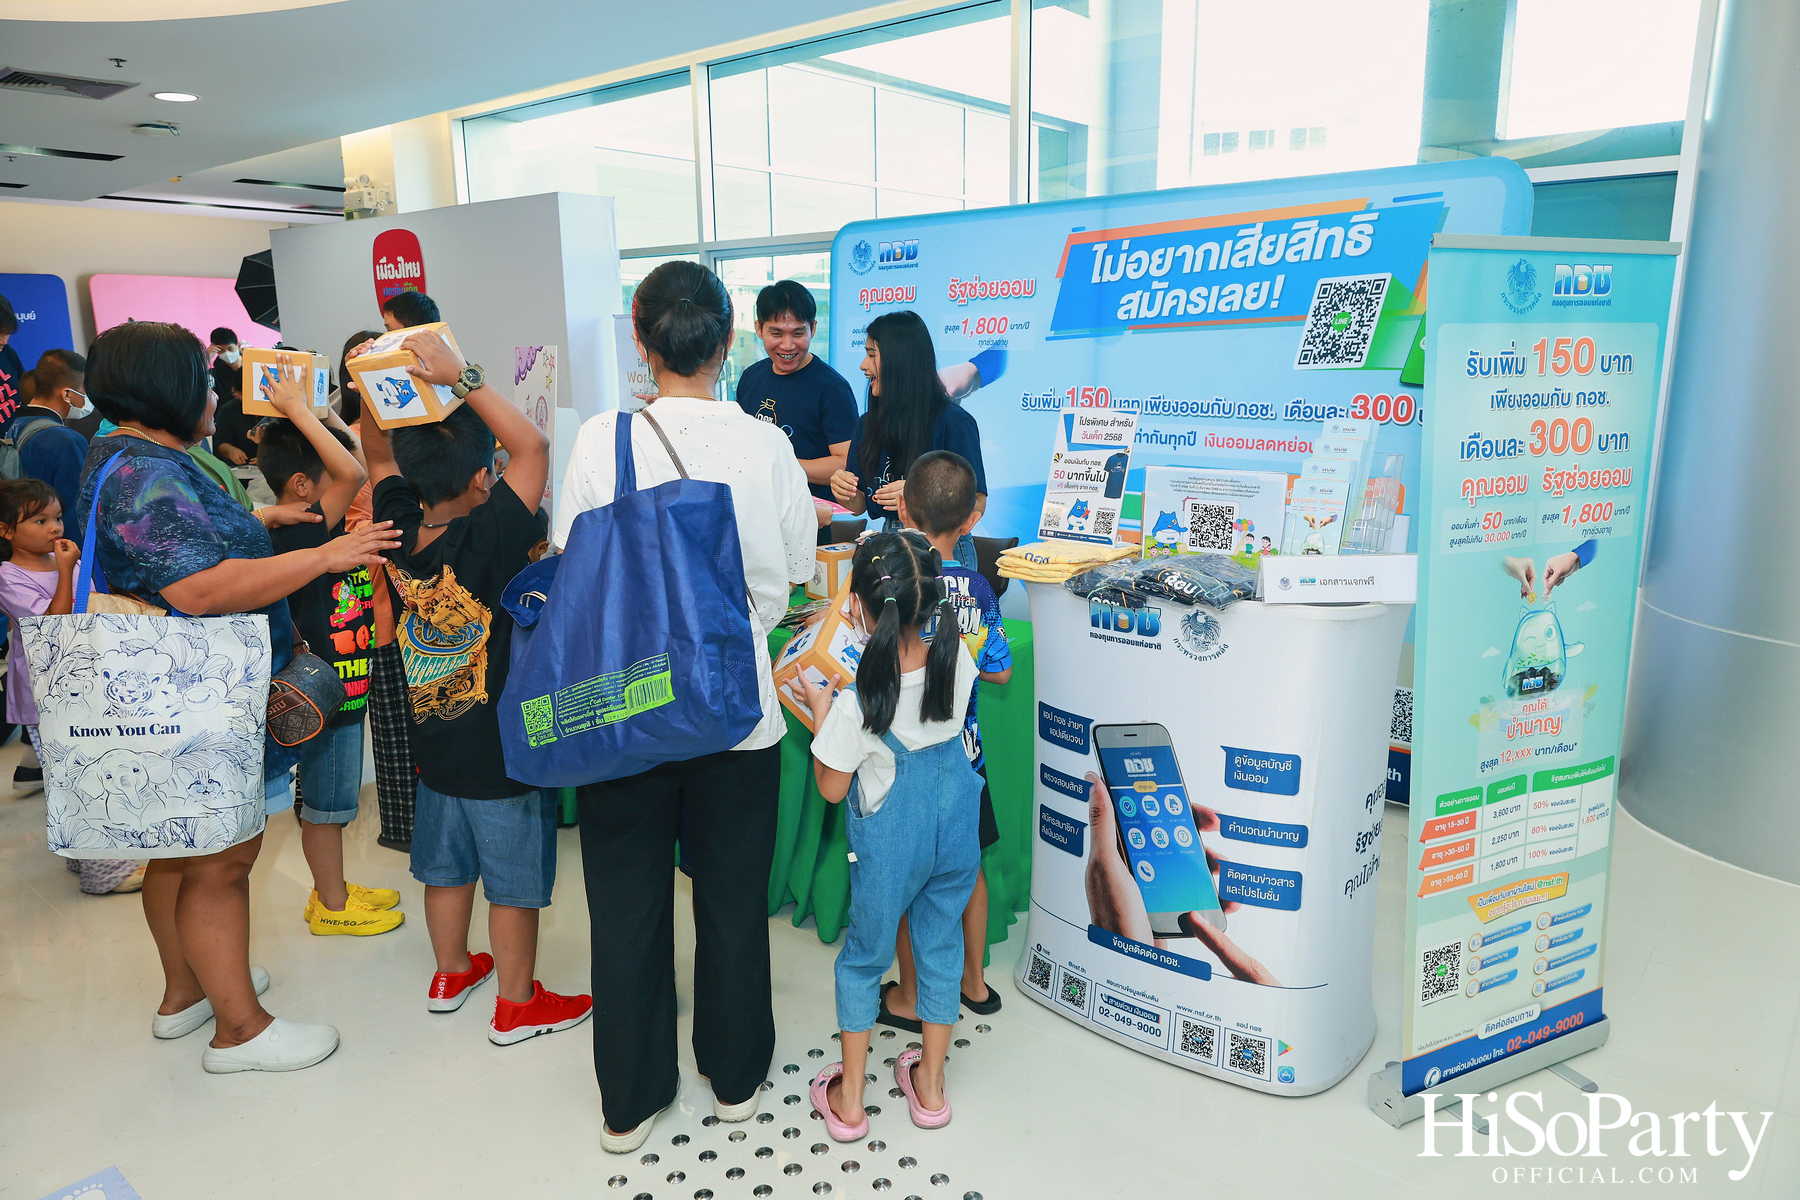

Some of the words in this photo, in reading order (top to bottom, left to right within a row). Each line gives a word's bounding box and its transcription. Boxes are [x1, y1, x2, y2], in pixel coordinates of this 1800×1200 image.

[1091, 213, 1380, 285] ไม่อยากเสียสิทธิ
[376, 256, 421, 281] เมืองไทย
[948, 275, 1035, 305] รัฐช่วยออม
[1553, 264, 1613, 297] กอช
[859, 285, 916, 310] คุณออม
[1117, 275, 1285, 321] สมัครเลย!
[961, 316, 1009, 338] 1,800
[1010, 321, 1030, 330] บาท/ปี
[1466, 341, 1526, 378] รับเพิ่ม
[1533, 337, 1596, 376] 150
[1601, 353, 1633, 374] บาท
[1021, 388, 1061, 410] รับเพิ่ม
[1066, 387, 1110, 408] 150
[1145, 396, 1233, 416] เพียงออมกับ
[1237, 402, 1274, 418] กอช.
[1284, 399, 1348, 419] เดือนละ
[1351, 394, 1415, 423] 300
[1490, 387, 1571, 411] เพียงออมกับ
[1576, 391, 1610, 407] กอช.
[1079, 417, 1108, 427] โปรพิเศษ
[1110, 418, 1133, 428] สำหรับ
[1081, 430, 1103, 440] วันเด็ก
[1104, 433, 1122, 441] 2568
[1134, 429, 1197, 451] ท่ากันทุกปี
[1460, 432, 1525, 461] เดือนละ
[1529, 417, 1594, 456] 300
[1598, 431, 1629, 453] บาท
[1053, 470, 1066, 480] 50
[1067, 467, 1107, 483] บาทขึ้นไป
[1542, 464, 1633, 497] รัฐช่วยออม
[1461, 472, 1528, 506] คุณออม
[1481, 510, 1503, 532] 50
[1541, 512, 1560, 525] สูงสุด
[1562, 502, 1614, 529] 1,800
[1484, 531, 1511, 544] 30,000
[1319, 575, 1375, 586] เอกสารแจกฟรี
[1089, 630, 1162, 651] กองทุนการออมแห่งชาติ
[1173, 636, 1229, 662] กระทรวงการคลัง
[333, 657, 368, 680] THE
[1522, 699, 1549, 716] คุณได้
[69, 725, 114, 739] Know
[116, 725, 146, 738] You
[149, 723, 181, 736] Can
[1053, 715, 1066, 726] กอช
[1506, 715, 1563, 741] บำนาญ
[1234, 755, 1293, 772] ดูข้อมูลบัญชี
[1480, 758, 1499, 772] สูงสุด
[1233, 770, 1269, 784] เงินออม
[1493, 807, 1509, 819] 3,600
[1509, 803, 1521, 815] บาท
[1532, 800, 1549, 810] 50%
[1447, 818, 1465, 830] 15-30
[1531, 824, 1548, 835] 80%
[1581, 814, 1596, 826] 1,800
[1228, 822, 1300, 843] คำนวณบำนาญ
[1491, 832, 1508, 846] 2,250
[1508, 830, 1520, 842] บาท
[1444, 845, 1465, 858] >30-50
[1528, 849, 1548, 860] 100%
[1490, 860, 1507, 872] 1,800
[1506, 856, 1518, 868] บาท
[1227, 868, 1295, 889] ติดตามข่าวสาร
[1442, 872, 1464, 885] >50-60
[1536, 876, 1563, 889] @nsf.th
[1226, 884, 1280, 902] และโปรโมชั่น
[320, 917, 358, 928] HWEI-5G
[1112, 936, 1159, 961] ข้อมูลติดต่อ
[1159, 953, 1181, 968] กอช.
[1098, 1006, 1162, 1038] 02-049-9000
[1176, 1004, 1222, 1022] www.nsf.or.th
[1484, 1008, 1534, 1035] ติดต่อสอบถาม
[1442, 1050, 1492, 1079] สายด่วนเงินออม
[1492, 1046, 1506, 1059] โทร.
[1506, 1011, 1585, 1053] 02-049-9000
